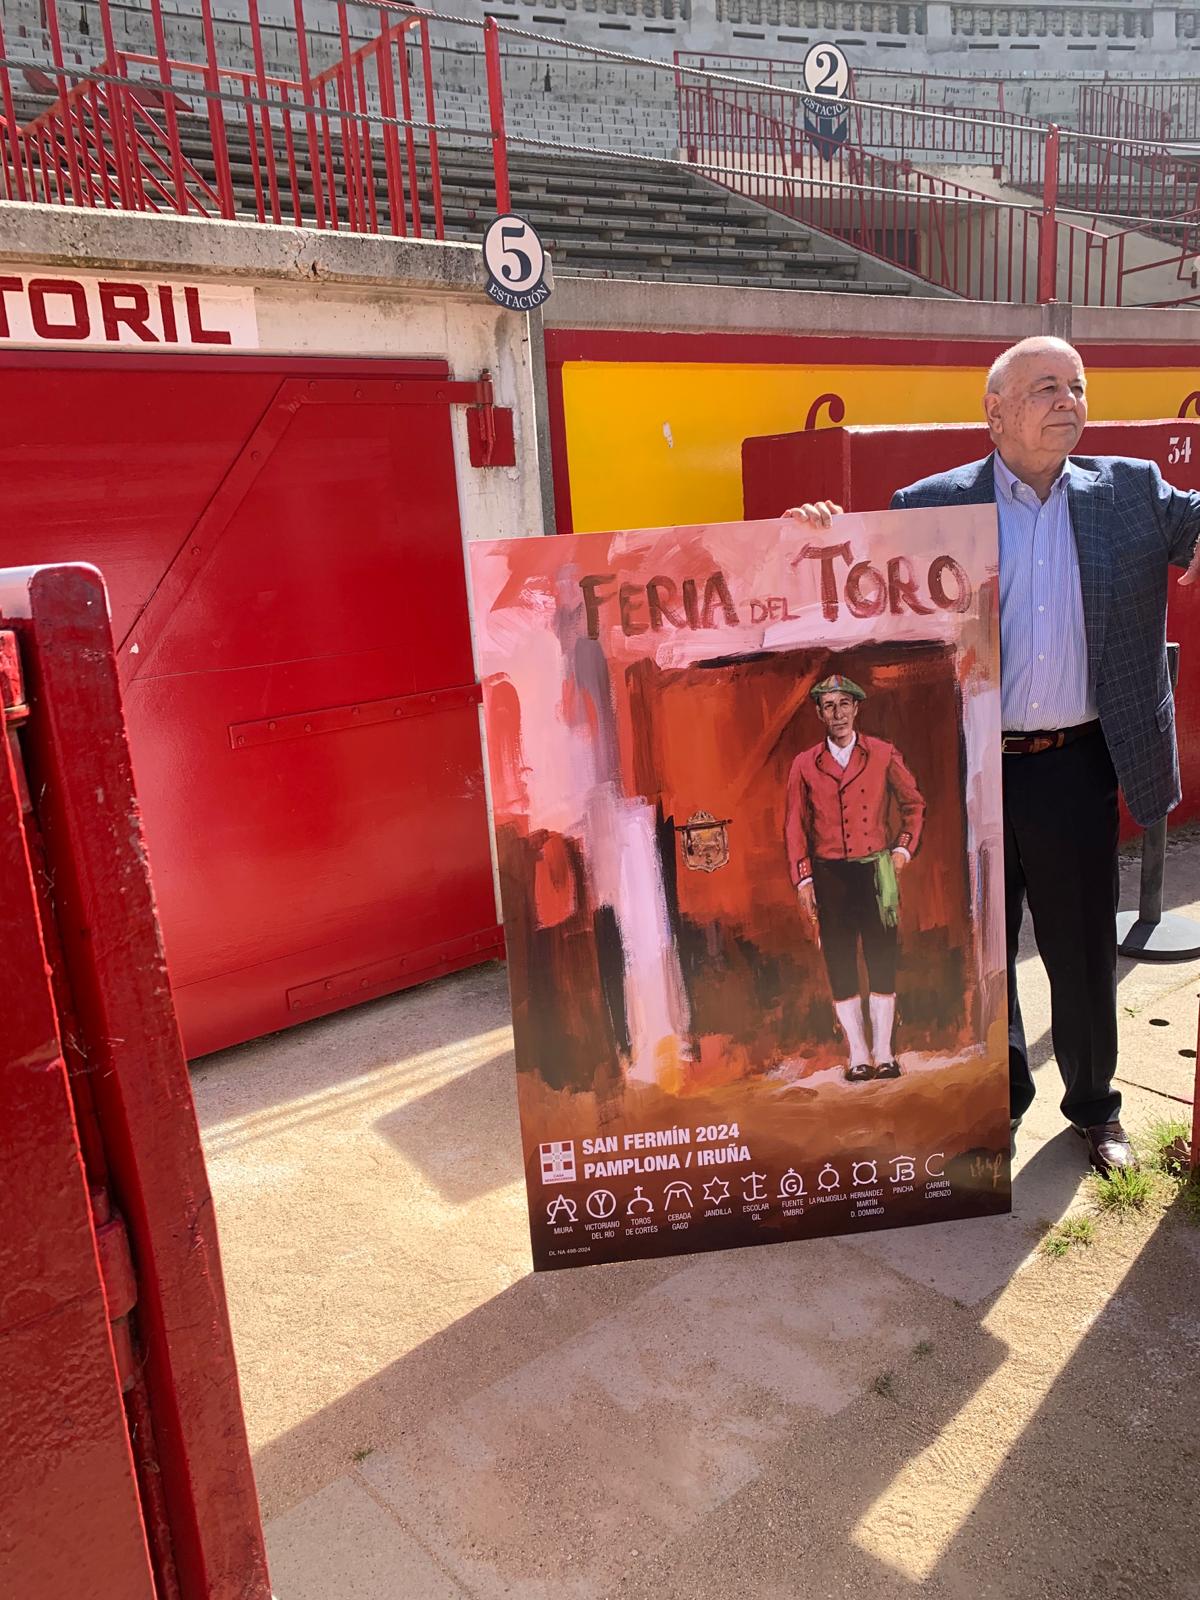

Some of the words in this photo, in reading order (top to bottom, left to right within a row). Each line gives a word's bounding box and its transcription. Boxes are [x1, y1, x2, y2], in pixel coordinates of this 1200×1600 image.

[815, 51, 838, 95] 2
[803, 97, 846, 116] ESTACIO
[502, 225, 532, 282] 5
[488, 282, 548, 308] ESTACIÓN
[578, 571, 739, 640] FERIA
[750, 596, 802, 624] DEL
[800, 541, 972, 623] TORO
[582, 1135, 618, 1155] SAN
[623, 1125, 690, 1150] FERMÍN
[695, 1123, 740, 1143] 2024
[584, 1154, 681, 1179] PAMPLONA
[685, 1152, 692, 1168] /
[697, 1143, 751, 1166] IRUÑA
[893, 1185, 914, 1194] PINCHA
[926, 1180, 950, 1190] CARMEN
[816, 1193, 847, 1204] PALMOSILLA
[925, 1189, 952, 1199] LORENZO
[742, 1203, 769, 1213] ESCOLAR
[782, 1199, 804, 1208] FUENTE
[856, 1198, 878, 1208] MARTÍN
[667, 1212, 692, 1222] CEBADA
[704, 1207, 732, 1217] JANDILLA
[751, 1213, 762, 1221] GIL
[782, 1208, 804, 1217] YMBRO
[857, 1207, 885, 1217] DOMINGO
[584, 1220, 620, 1231] VICTORIANO
[631, 1217, 651, 1226] TOROS
[672, 1222, 689, 1231] GAGO
[554, 1226, 574, 1235] MIURA
[625, 1228, 634, 1236] DE
[592, 1232, 603, 1240] DEL
